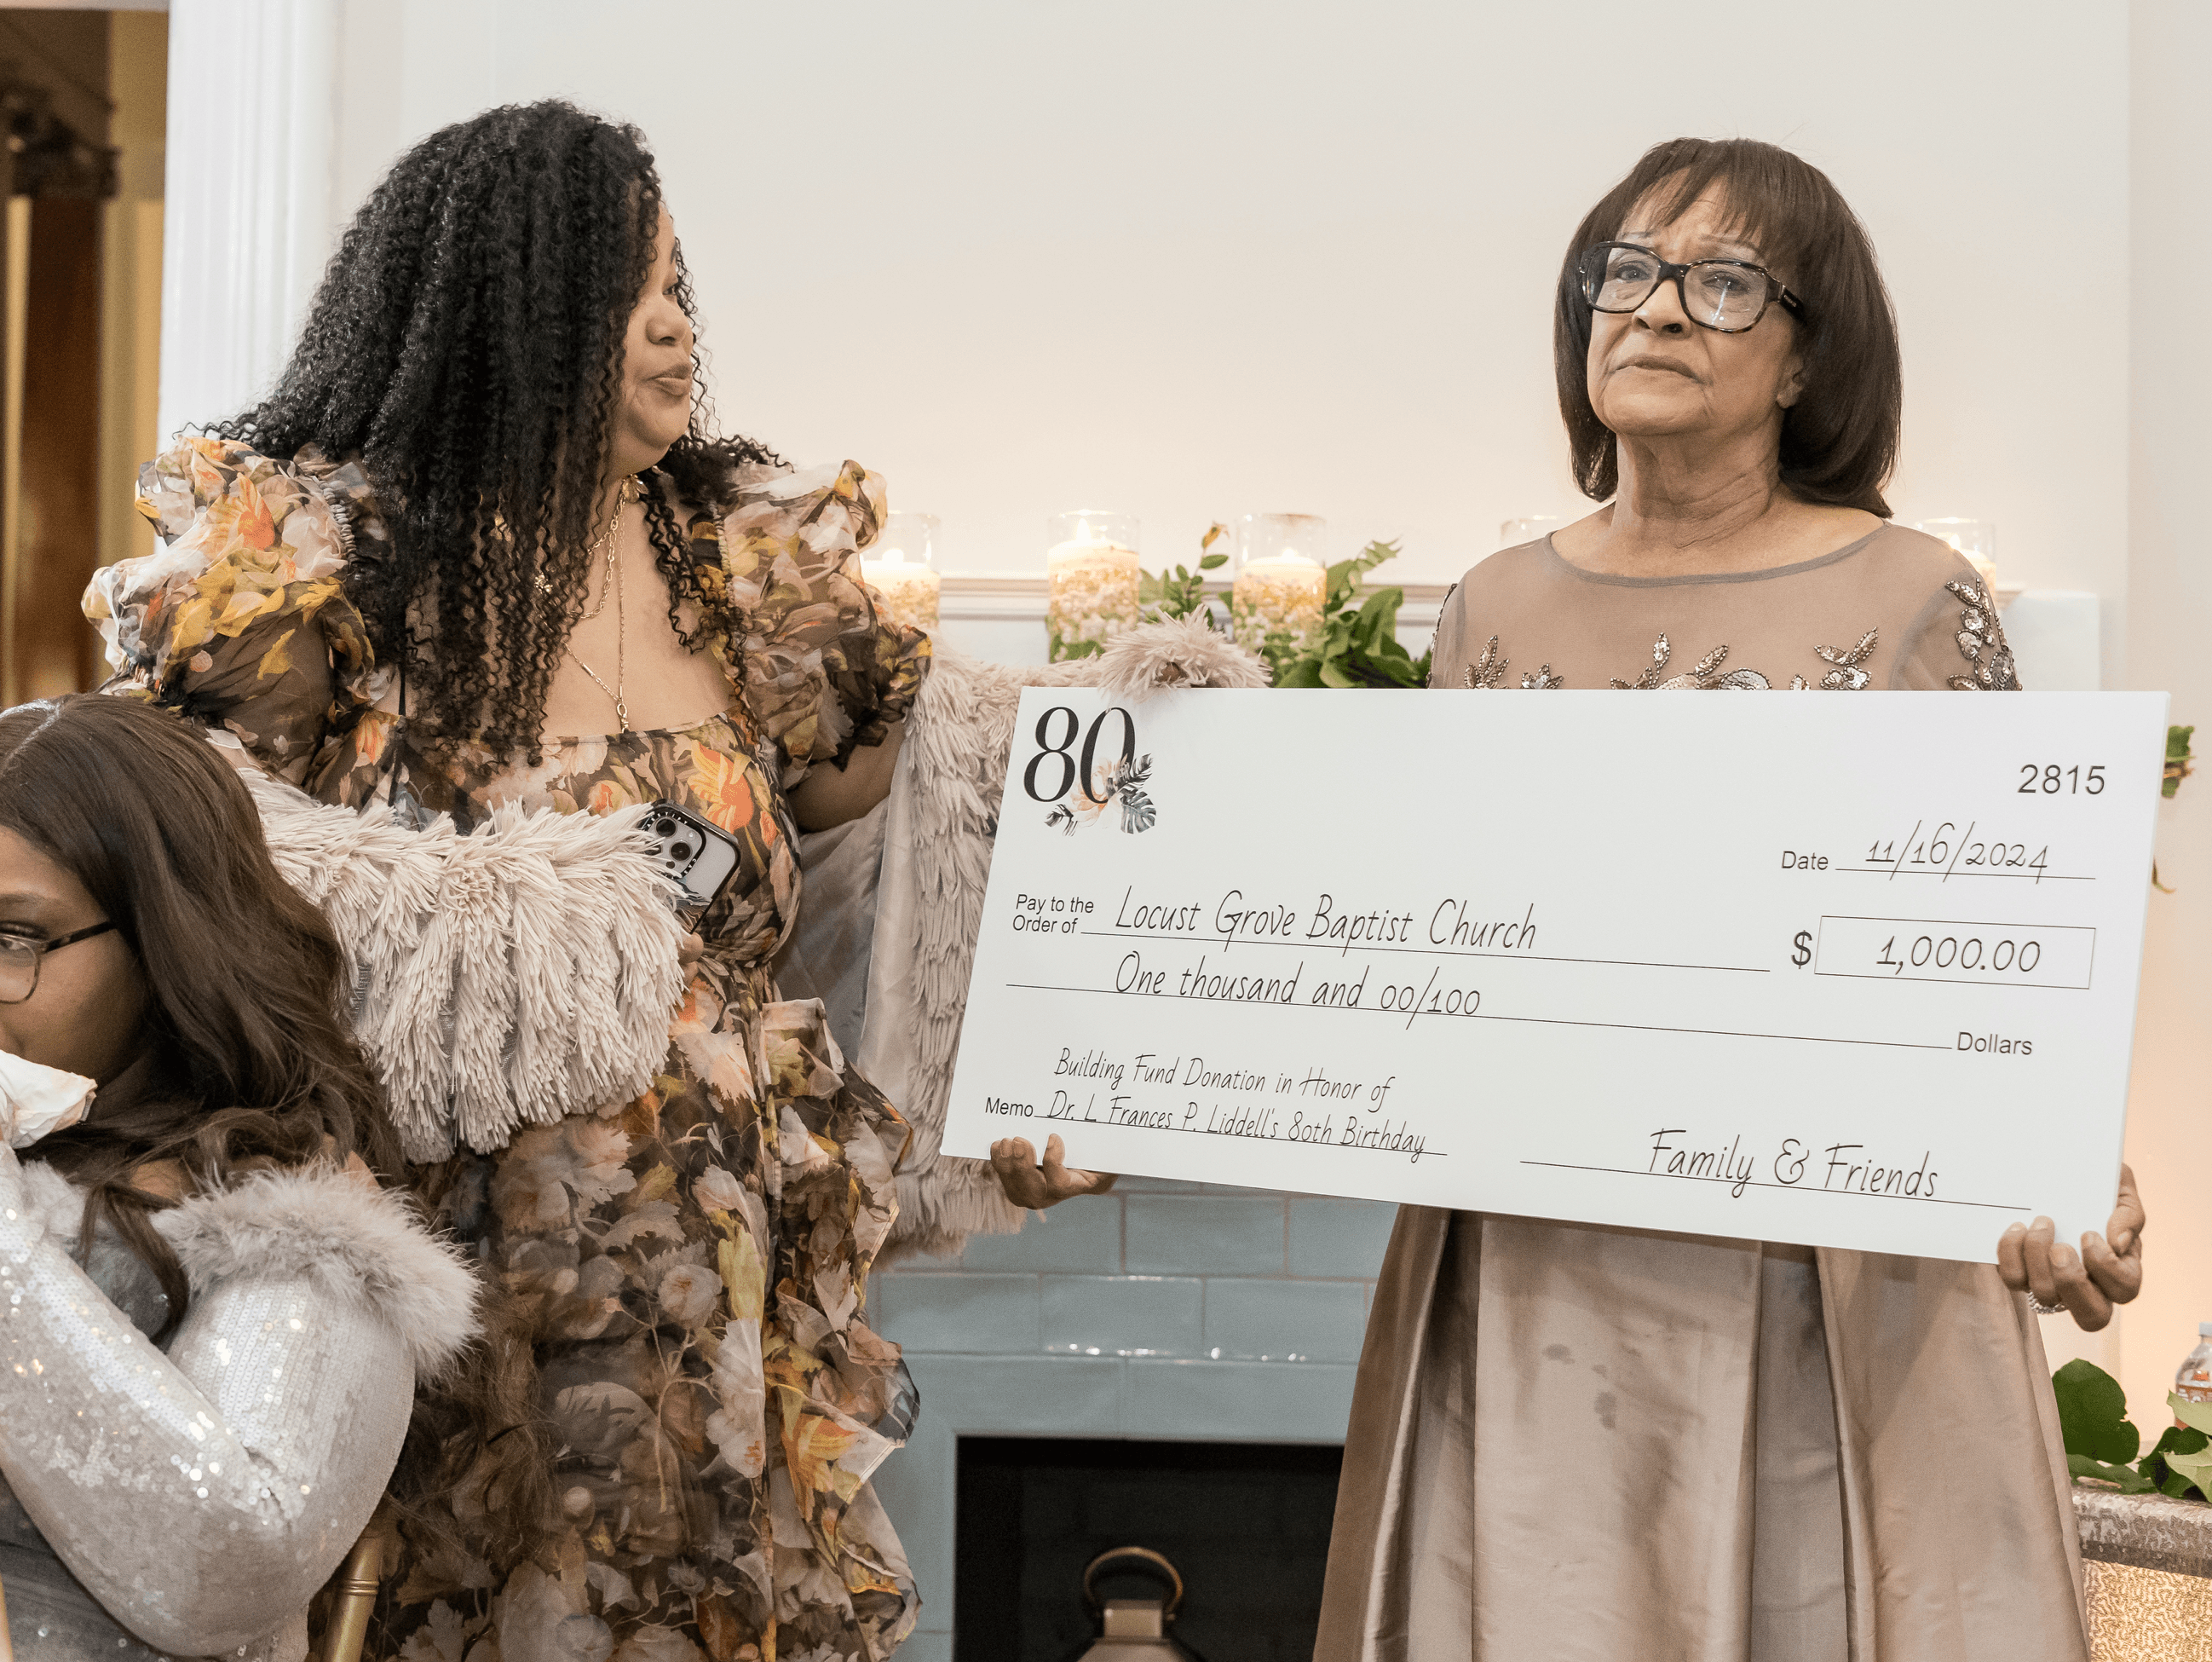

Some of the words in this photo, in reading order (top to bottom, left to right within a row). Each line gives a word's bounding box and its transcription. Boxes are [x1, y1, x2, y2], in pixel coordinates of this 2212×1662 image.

[1023, 707, 1135, 804] 80
[2018, 765, 2105, 794] 2815
[1782, 851, 1829, 870] Date
[1865, 820, 2048, 884] 11/16/2024
[1012, 915, 1057, 932] Order
[1061, 917, 1079, 933] of
[1016, 894, 1046, 915] Pay
[1051, 896, 1065, 912] to
[1070, 897, 1094, 914] the
[1115, 886, 1201, 931] Locust
[1215, 890, 1295, 953] Grove
[1305, 894, 1414, 957] Baptist
[1429, 898, 1536, 949] Church
[1790, 930, 1813, 970] $
[1875, 935, 2041, 975] 1,000.00
[1115, 950, 1166, 994] One
[1180, 955, 1304, 1002] thousand
[1312, 965, 1370, 1007] and
[1380, 967, 1481, 1030] 00/100
[1956, 1032, 2032, 1056] Dollars
[1053, 1047, 1125, 1091] Building
[1134, 1053, 1180, 1084] Fund
[1183, 1057, 1265, 1093] Donation
[1275, 1072, 1293, 1094] in
[1299, 1067, 1362, 1099] Honor
[1367, 1076, 1396, 1113] of
[984, 1097, 1034, 1117] Memo
[1046, 1090, 1075, 1121] Dr.
[1084, 1093, 1097, 1122] L
[1109, 1095, 1173, 1129] Frances
[1182, 1101, 1199, 1133] P.
[1207, 1104, 1279, 1139] Liddell's
[1287, 1111, 1333, 1144] 80th
[1339, 1116, 1426, 1163] Birthday
[1649, 1128, 1754, 1198] Family
[1774, 1139, 1810, 1185] &
[1823, 1142, 1938, 1197] Friends
